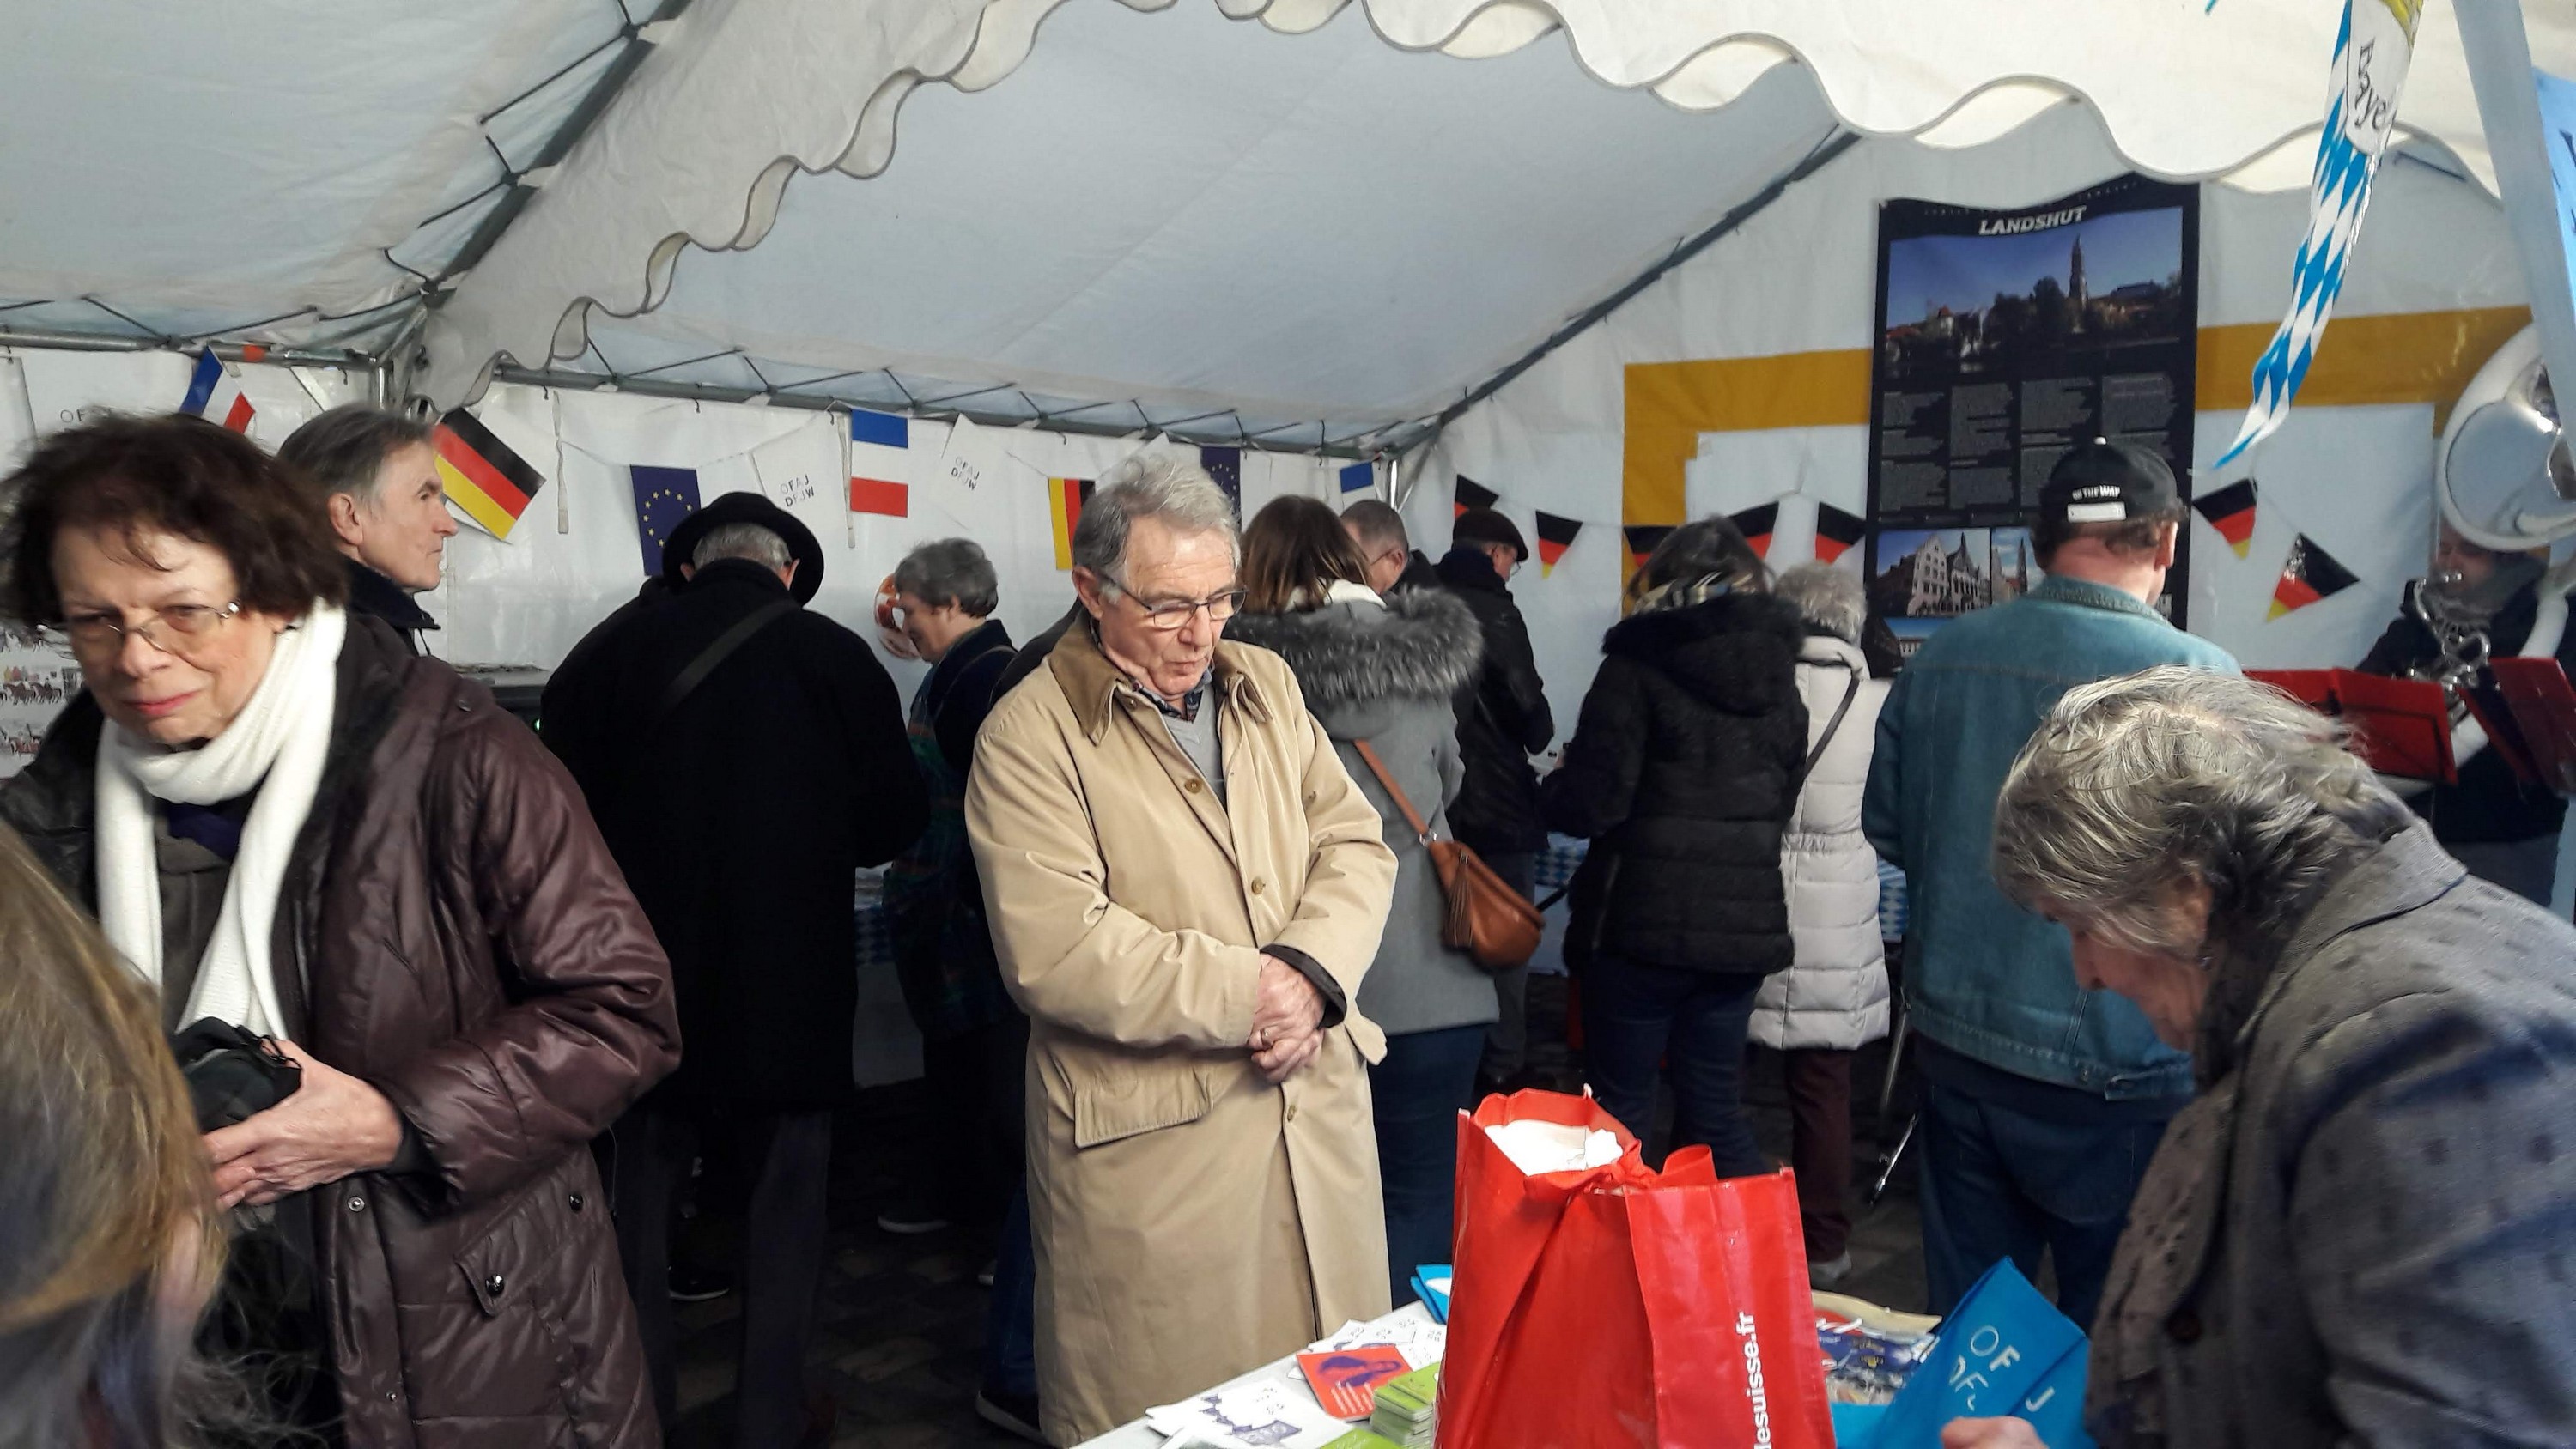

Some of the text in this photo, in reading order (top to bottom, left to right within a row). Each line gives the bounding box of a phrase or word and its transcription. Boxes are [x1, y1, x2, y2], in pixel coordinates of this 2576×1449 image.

[1978, 204, 2087, 236] LANDSHUT
[780, 474, 810, 495] OFAJ
[2099, 484, 2121, 498] WAY
[785, 485, 815, 507] DFJW
